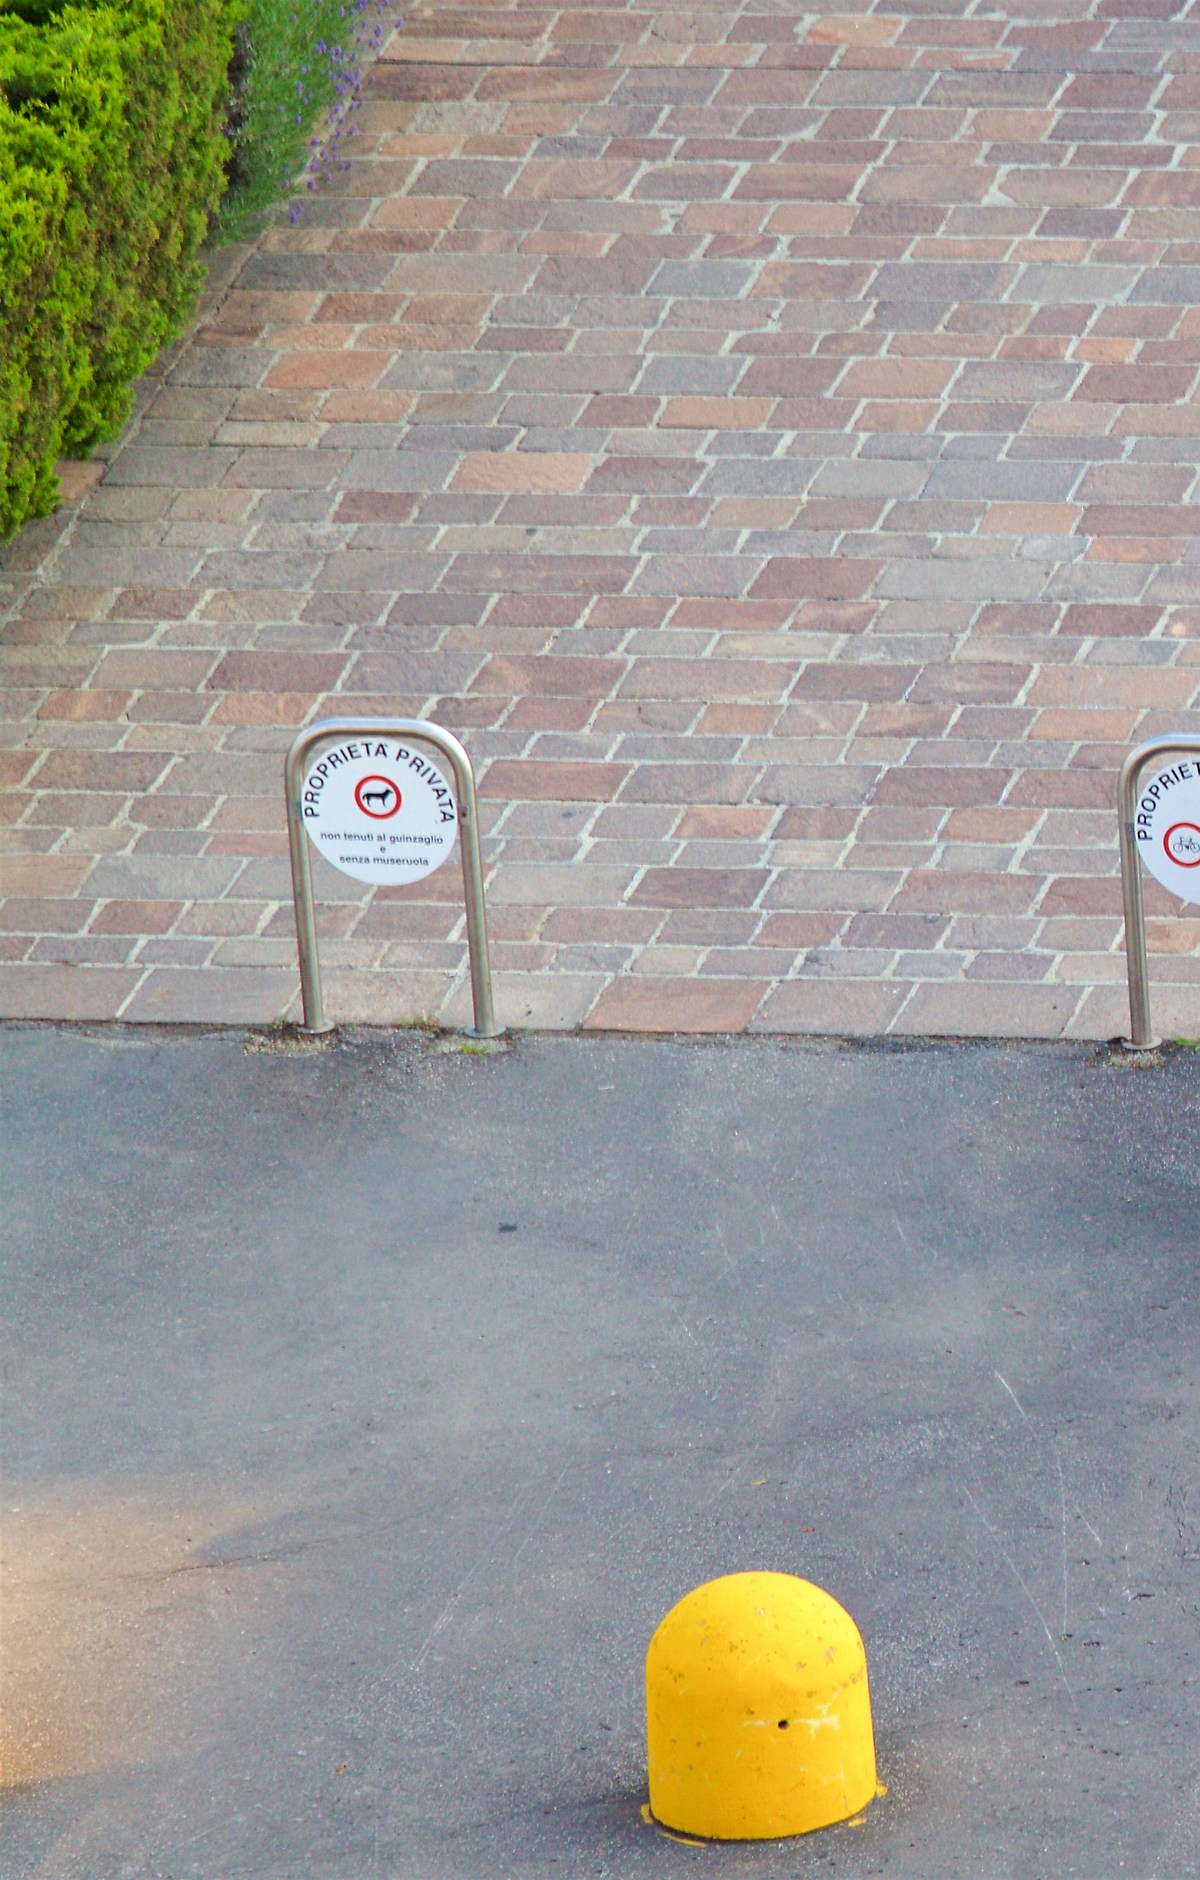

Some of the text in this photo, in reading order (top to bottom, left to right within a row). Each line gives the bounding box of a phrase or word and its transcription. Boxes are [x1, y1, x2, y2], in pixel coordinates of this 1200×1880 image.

[304, 742, 455, 823] PROPRIETÀ PRIVATA
[320, 832, 443, 846] non tenuti al guinzaglio
[339, 856, 429, 866] senza museruola
